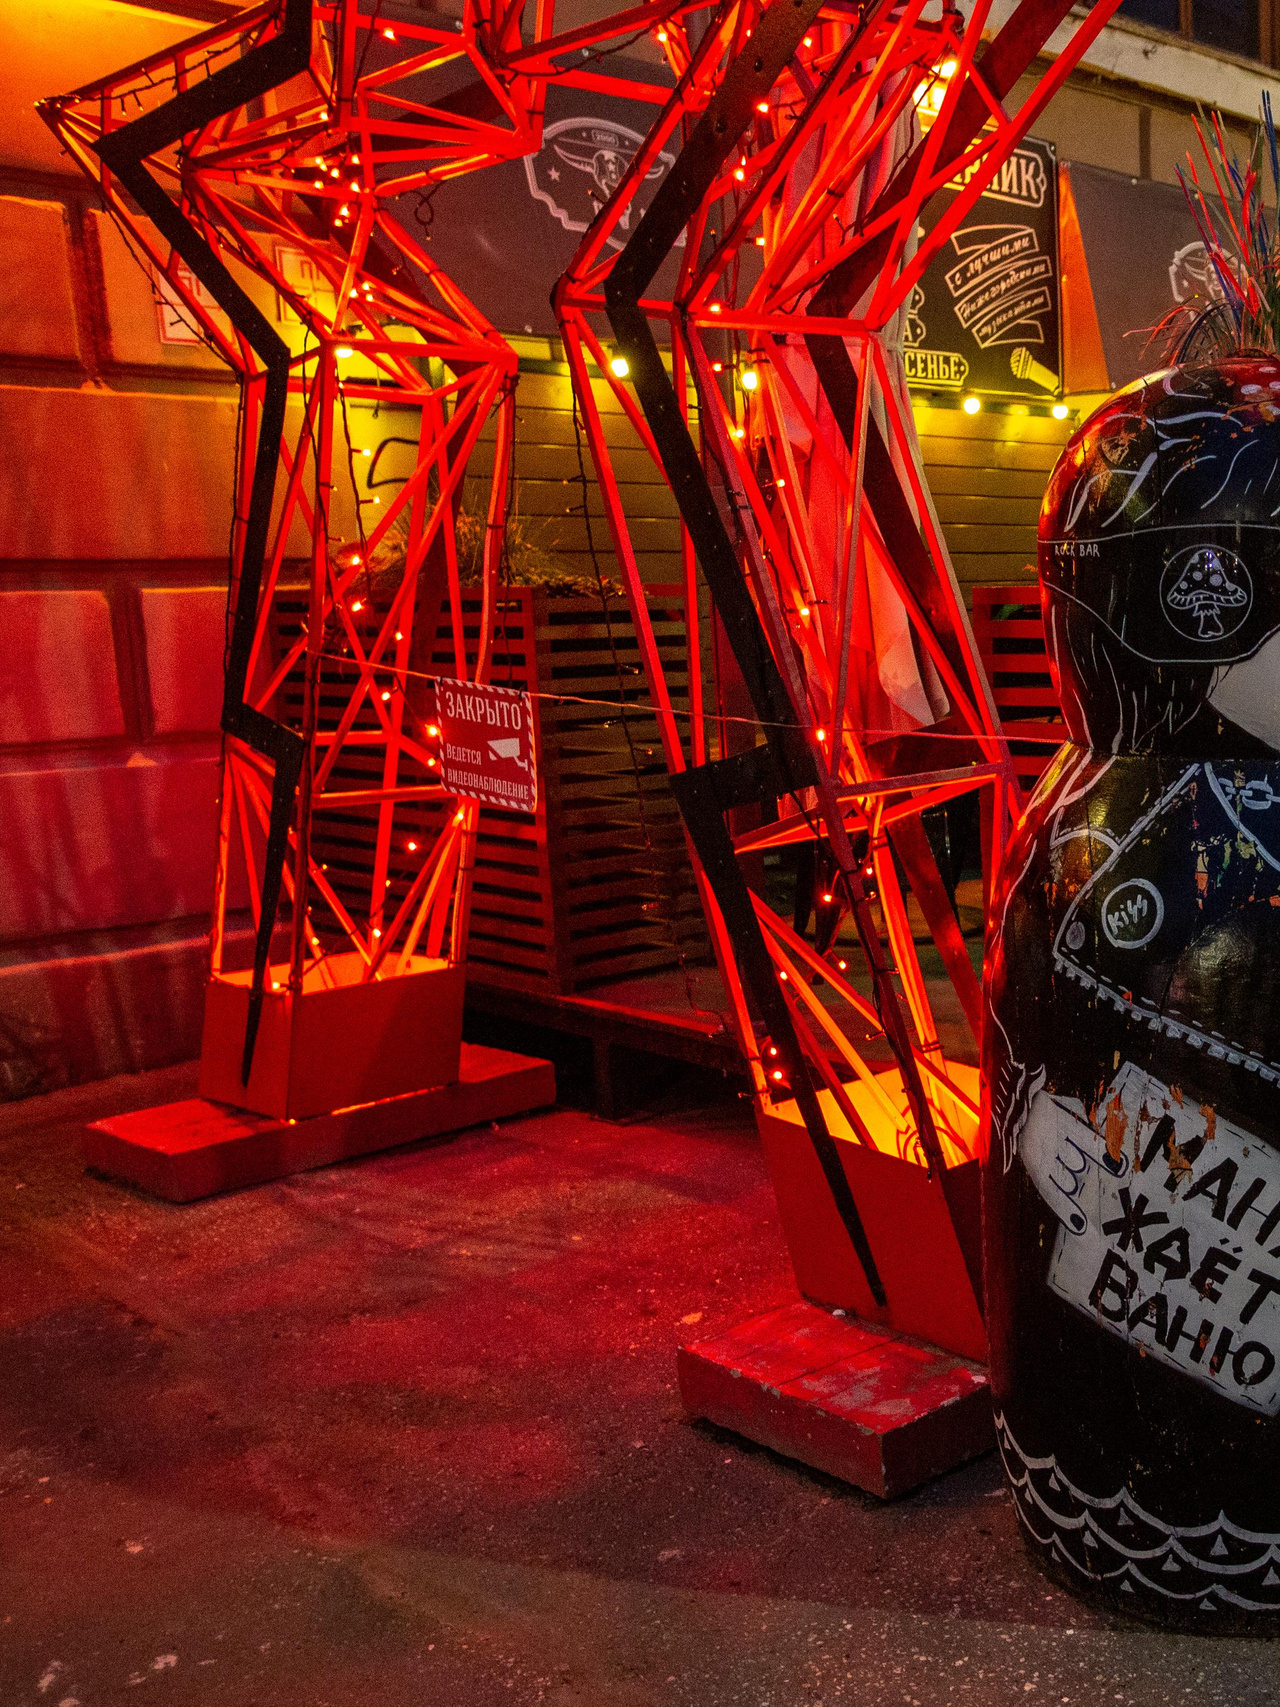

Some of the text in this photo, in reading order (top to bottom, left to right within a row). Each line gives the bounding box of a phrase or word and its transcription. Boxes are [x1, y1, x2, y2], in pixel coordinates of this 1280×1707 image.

[966, 237, 1030, 278] лучшими
[1054, 543, 1101, 557] ROCK BAR
[446, 691, 522, 730] ЗАКРЫТО
[446, 743, 482, 766] ВЕДЕТСЯ
[447, 768, 529, 800] ВИДЕОНАБЛЮДЕНИЕ
[1089, 1248, 1276, 1386] ВАНЮ
